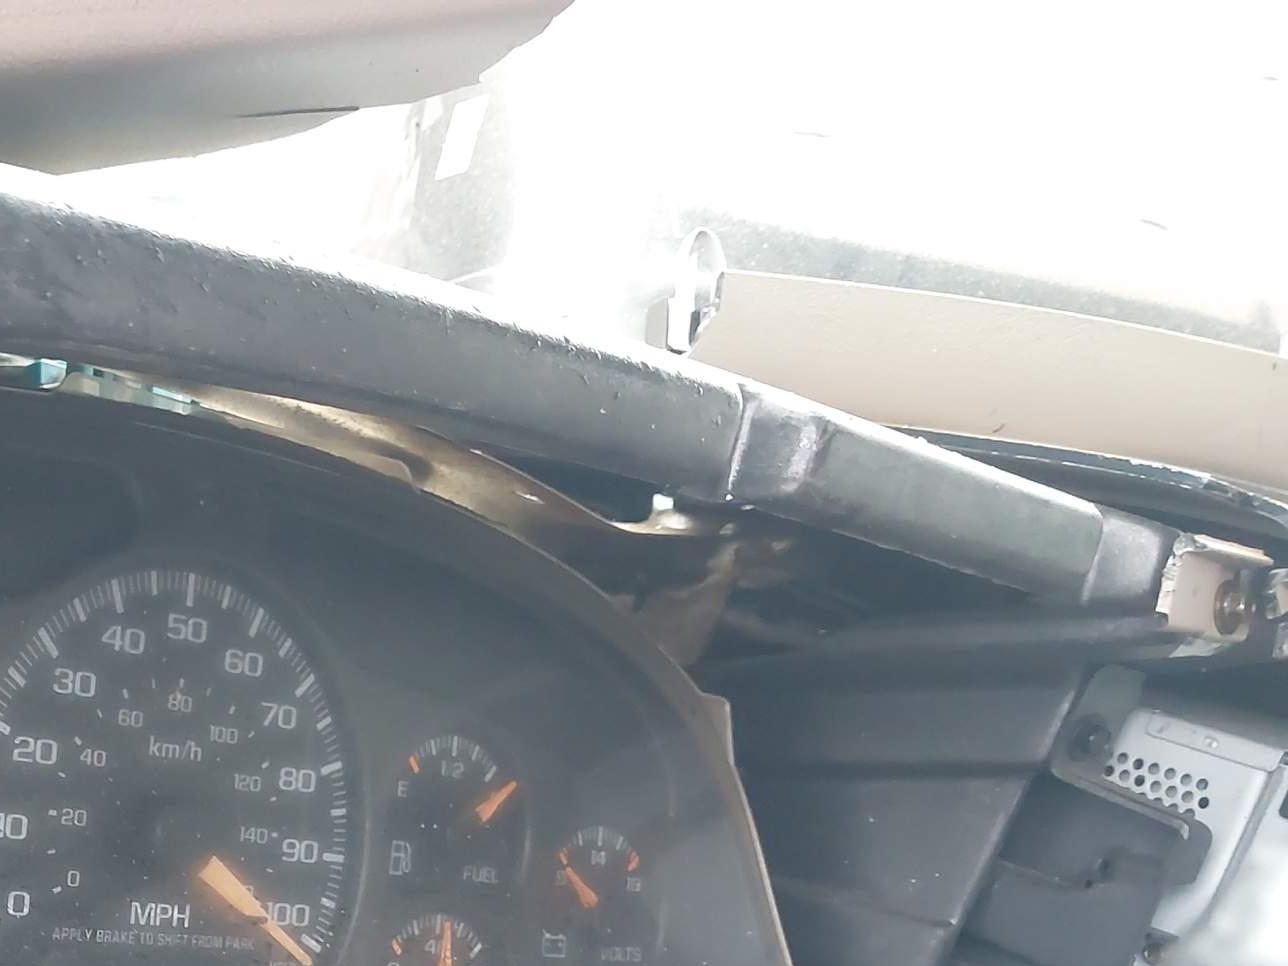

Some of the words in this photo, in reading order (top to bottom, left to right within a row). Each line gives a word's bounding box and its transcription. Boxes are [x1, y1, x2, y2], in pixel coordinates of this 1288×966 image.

[167, 613, 209, 644] 50
[101, 625, 146, 655] 40
[224, 650, 264, 678] 60
[53, 667, 97, 698] 30
[168, 694, 193, 714] 80
[117, 708, 144, 729] 60
[261, 702, 297, 730] 70
[210, 725, 239, 745] 100
[12, 736, 58, 766] 20
[79, 748, 107, 769] 40
[148, 735, 203, 763] km/h
[234, 772, 261, 793] 120
[278, 766, 317, 793] 80
[397, 780, 409, 797] E
[60, 807, 88, 828] 20
[239, 825, 269, 845] 140
[281, 837, 319, 865] 90
[66, 870, 81, 888] 0
[463, 865, 498, 884] FUEL
[7, 891, 31, 917] 0
[130, 901, 191, 929] MPH
[52, 927, 91, 942] APPLY
[96, 928, 136, 944] BRAKE
[139, 932, 154, 946] TO
[601, 946, 642, 962] VOLTS
